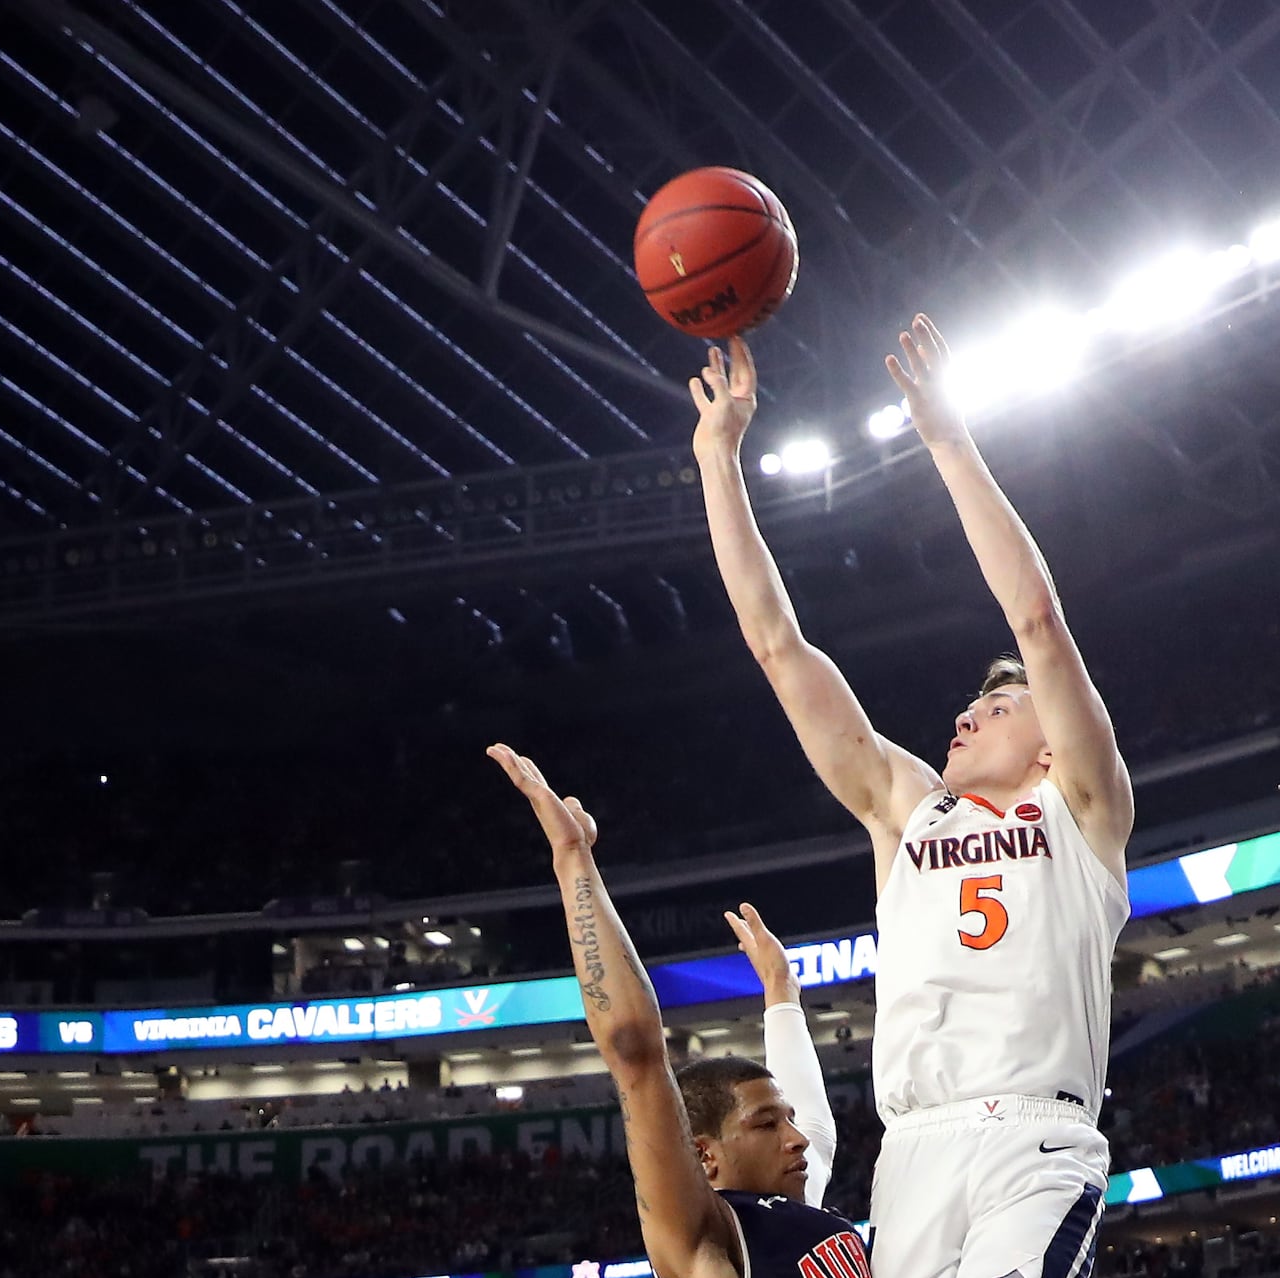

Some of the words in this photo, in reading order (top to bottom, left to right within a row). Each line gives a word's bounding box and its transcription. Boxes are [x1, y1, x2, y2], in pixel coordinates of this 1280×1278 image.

[905, 826, 1053, 874] VIRGINIA
[957, 874, 1009, 951] 5
[59, 1021, 93, 1043] VS
[133, 1015, 241, 1041] VIRGINIA
[247, 996, 441, 1040] CAVALIERS
[137, 1140, 277, 1183] THE
[516, 1110, 627, 1161] EN
